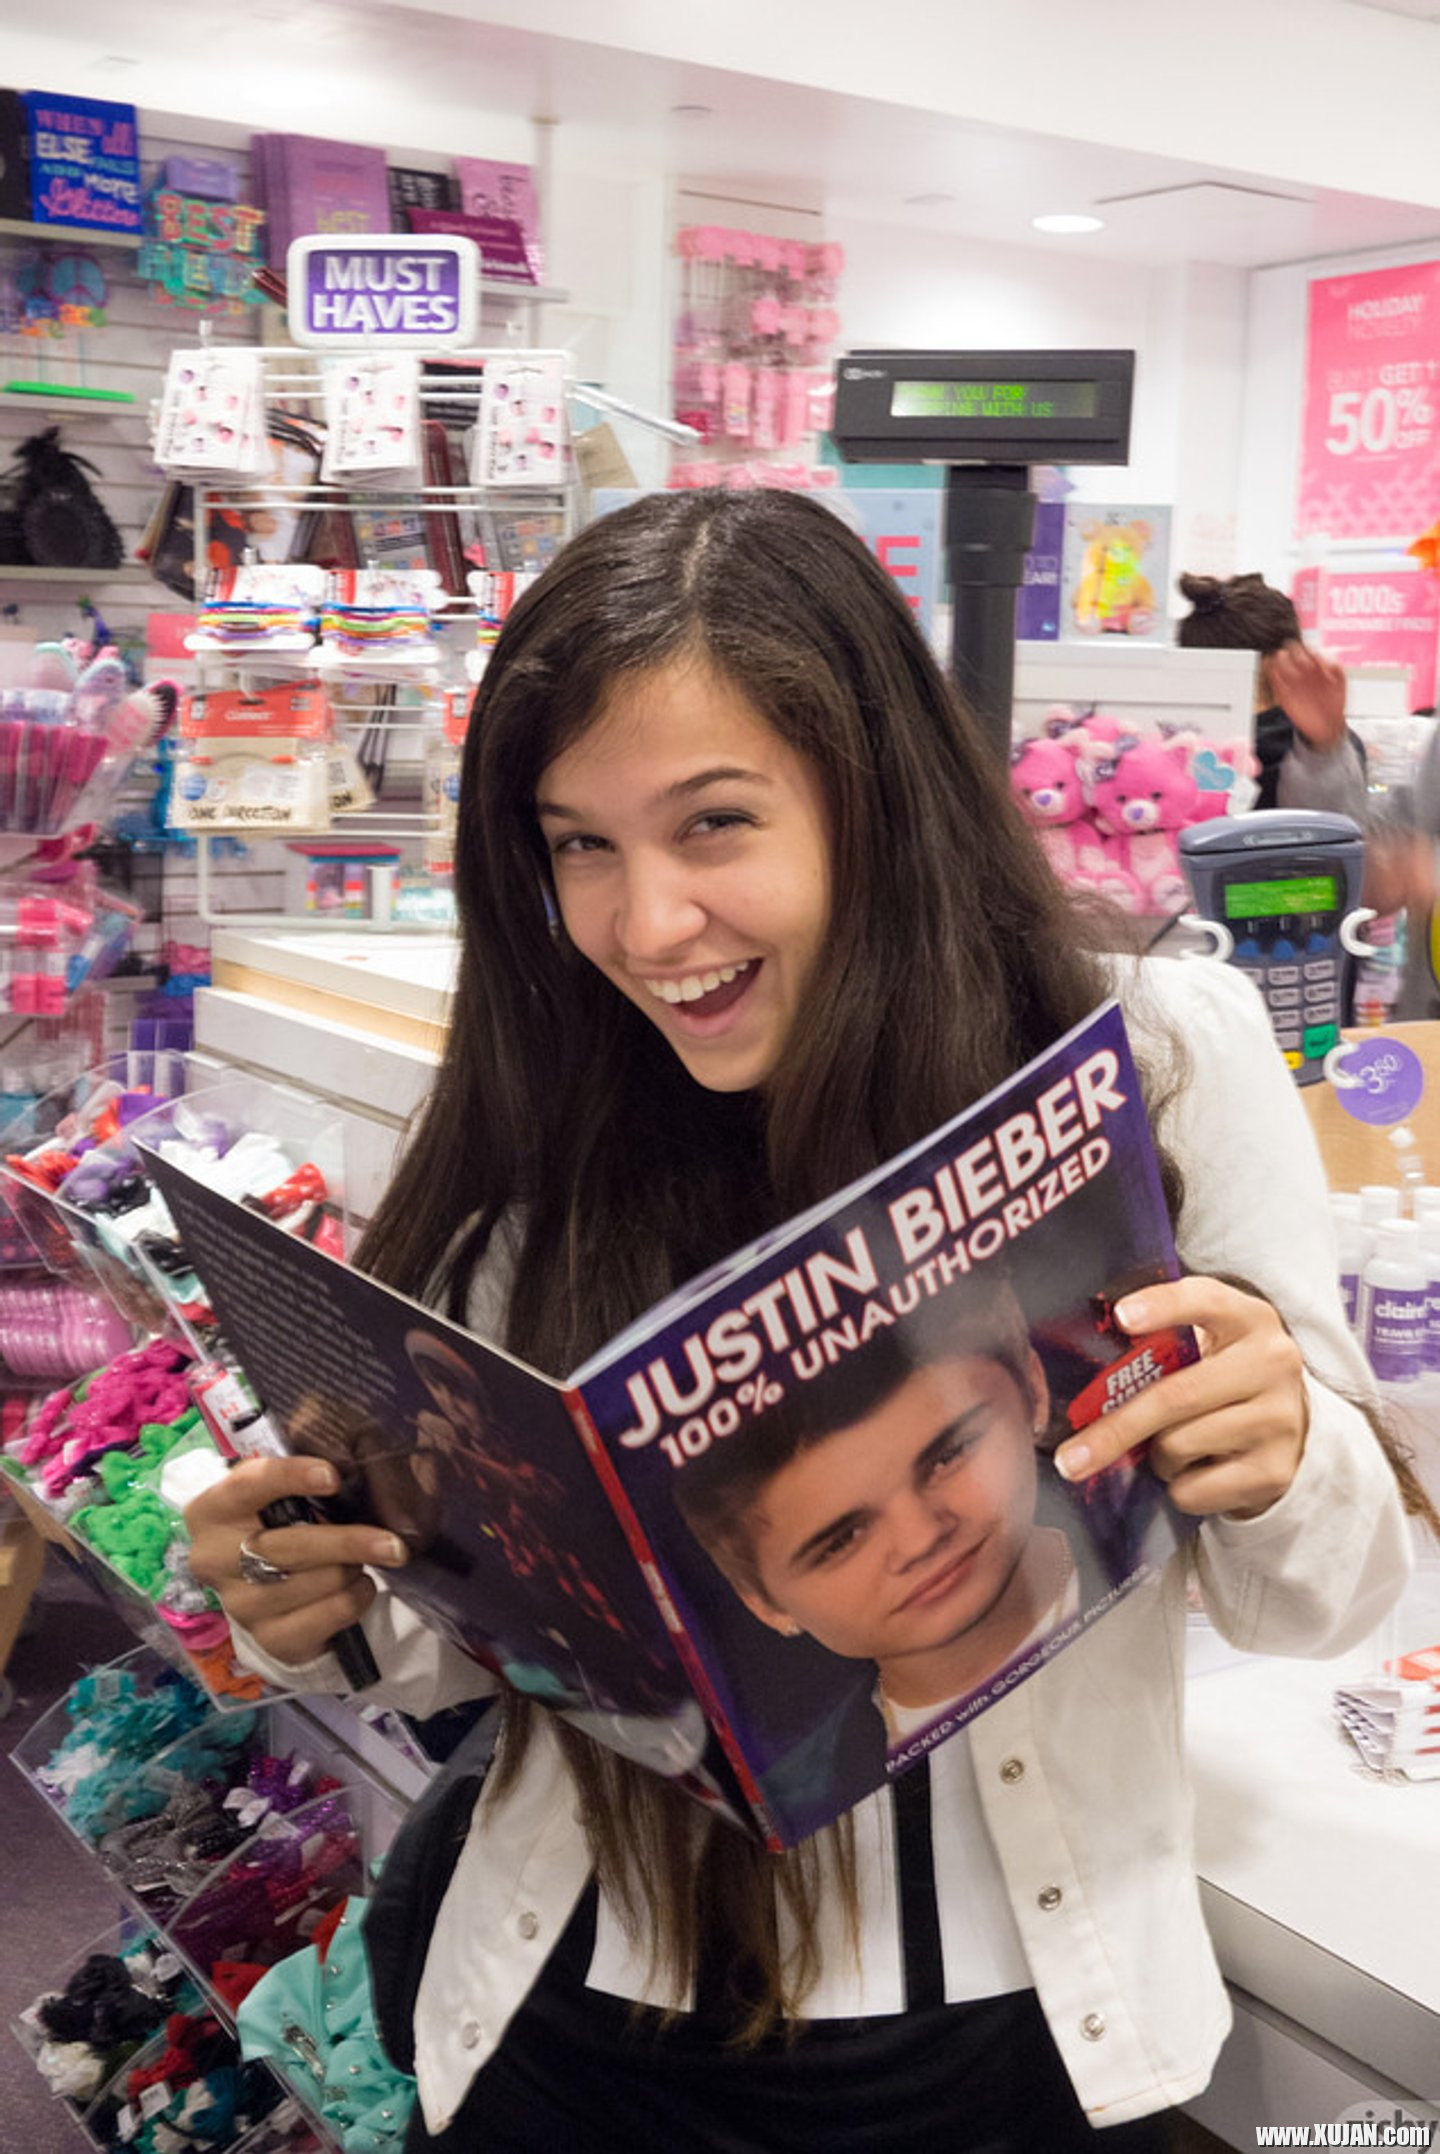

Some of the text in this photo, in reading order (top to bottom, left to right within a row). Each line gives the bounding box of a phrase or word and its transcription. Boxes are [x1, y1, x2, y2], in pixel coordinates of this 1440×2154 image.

[312, 294, 456, 331] HAVES
[324, 256, 449, 292] MUST
[619, 1226, 880, 1448] JUSTIN
[887, 1049, 1127, 1264] BIEBER
[659, 1137, 1112, 1467] 100% UNAUTHORIZED
[1106, 1348, 1154, 1397] FREE
[885, 1718, 953, 1774] PACKED
[955, 1693, 989, 1724] with
[991, 1621, 1083, 1696] GORGEOUS
